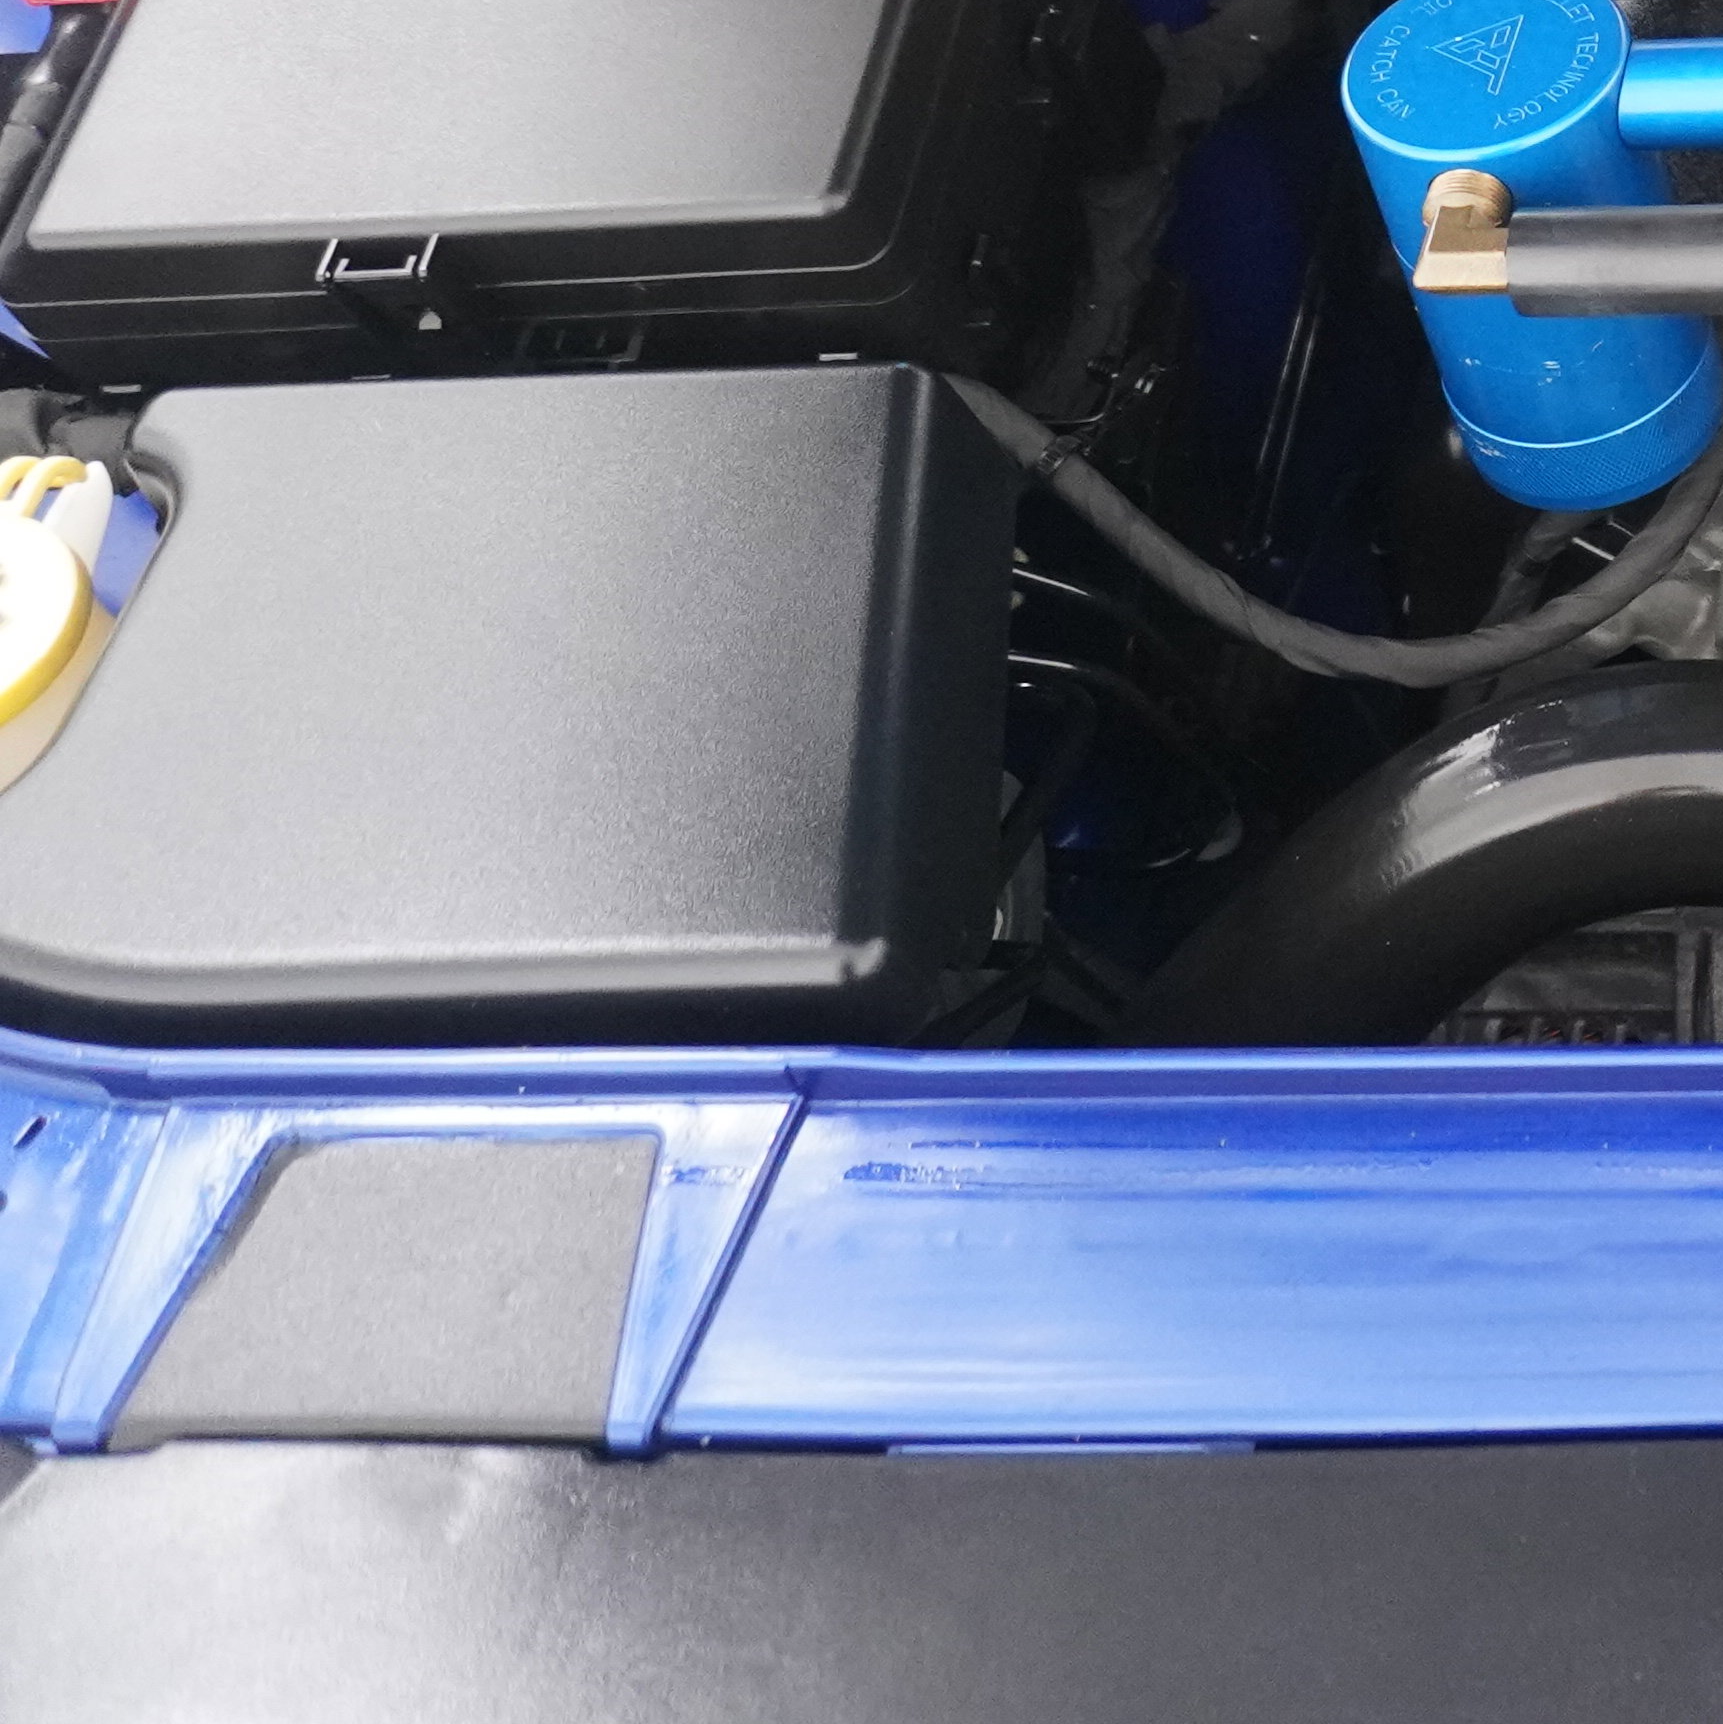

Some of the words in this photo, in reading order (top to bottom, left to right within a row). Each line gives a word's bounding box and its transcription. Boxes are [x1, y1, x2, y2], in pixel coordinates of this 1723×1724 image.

[1369, 24, 1411, 84] CATCH
[1494, 31, 1600, 131] TECHNOLOGY
[1376, 88, 1416, 122] CAN
